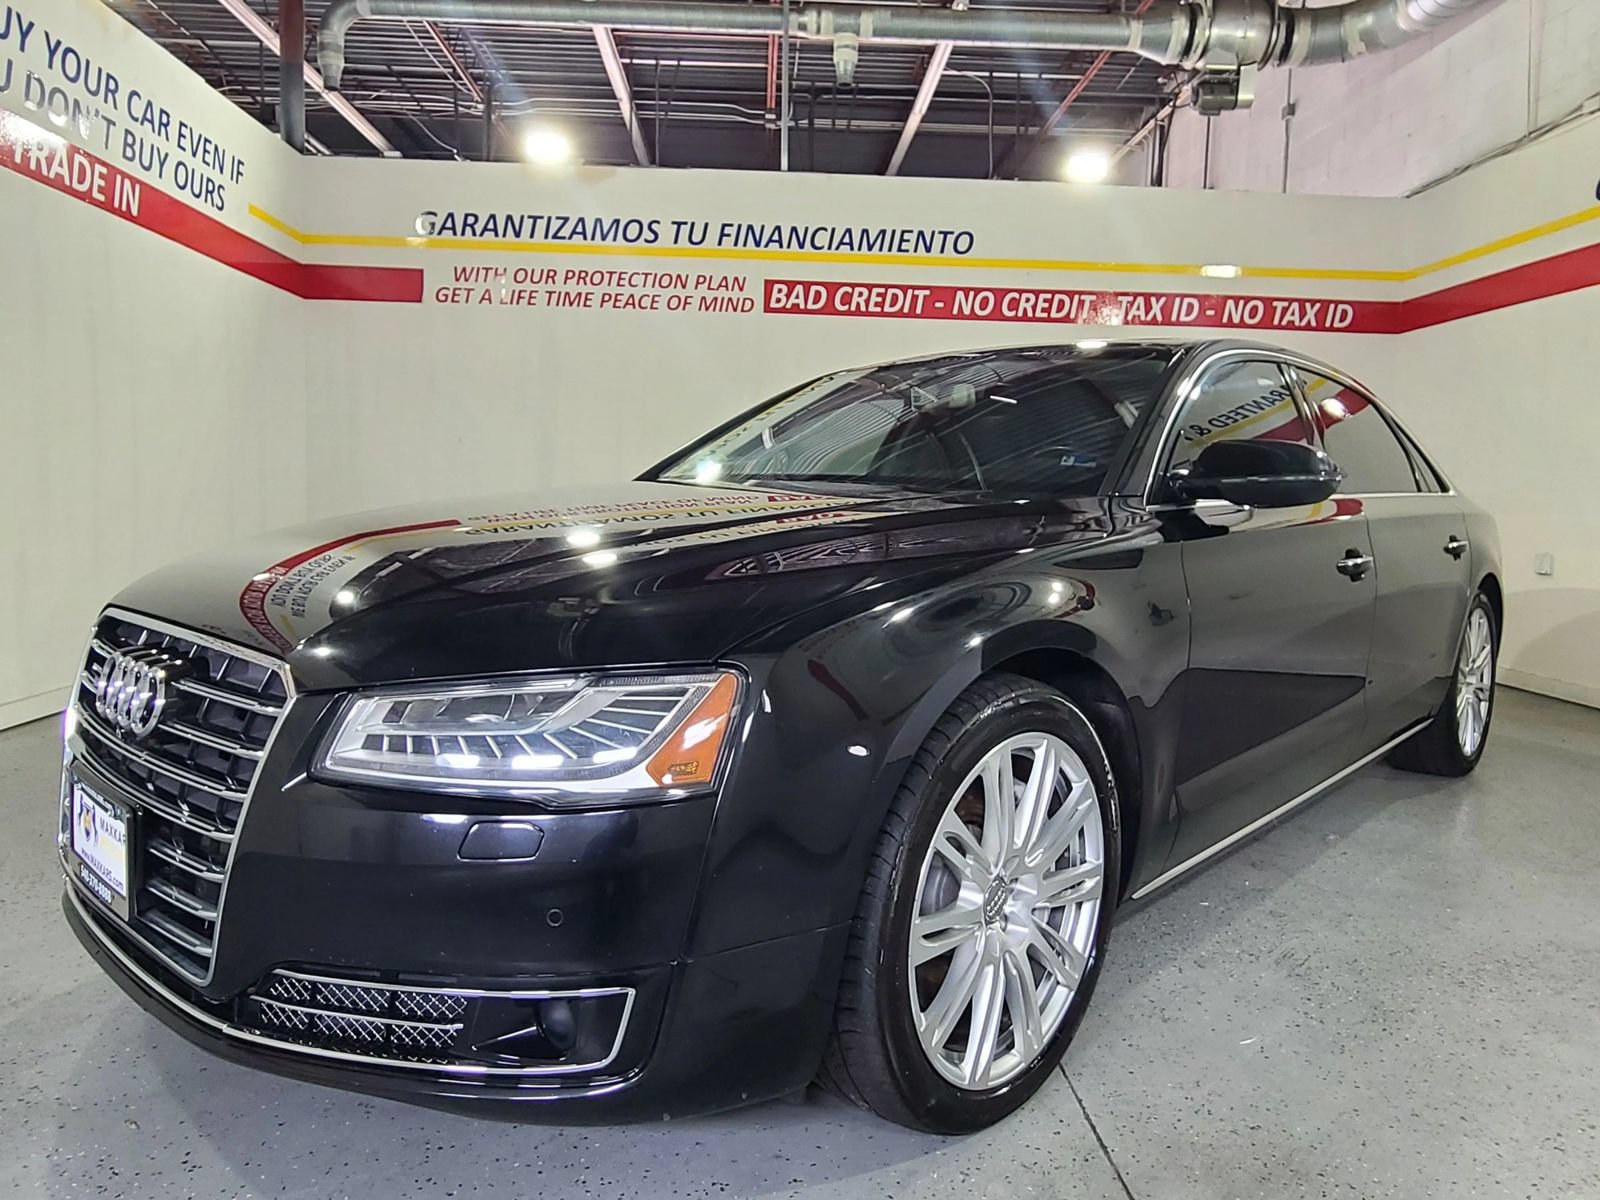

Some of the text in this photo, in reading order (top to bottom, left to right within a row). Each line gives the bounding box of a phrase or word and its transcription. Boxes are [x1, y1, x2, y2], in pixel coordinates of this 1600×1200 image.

[44, 30, 118, 111] YOUR
[127, 89, 169, 142] CAR
[177, 119, 225, 175] EVEN
[231, 155, 245, 185] IF
[24, 70, 116, 150] DON'T
[122, 127, 169, 179] BUY
[174, 160, 225, 212] OURS
[12, 136, 141, 217] TRADE IN
[414, 210, 976, 256] GARANTIZAMOS TU FINANCIAMIENTO
[434, 286, 756, 314] GET A LIFE TIME PEACE OF MIND
[452, 265, 747, 292] WITH OUR PROTECTION PLAN
[768, 282, 828, 311] BAD
[833, 285, 931, 316] CREDIT
[952, 289, 995, 317] NO
[1001, 291, 1098, 320] CREDIT
[1116, 294, 1167, 322] TAX
[1170, 296, 1201, 323] ID
[1222, 298, 1265, 326] NO
[1272, 300, 1322, 328] TAX
[1324, 302, 1355, 329] ID
